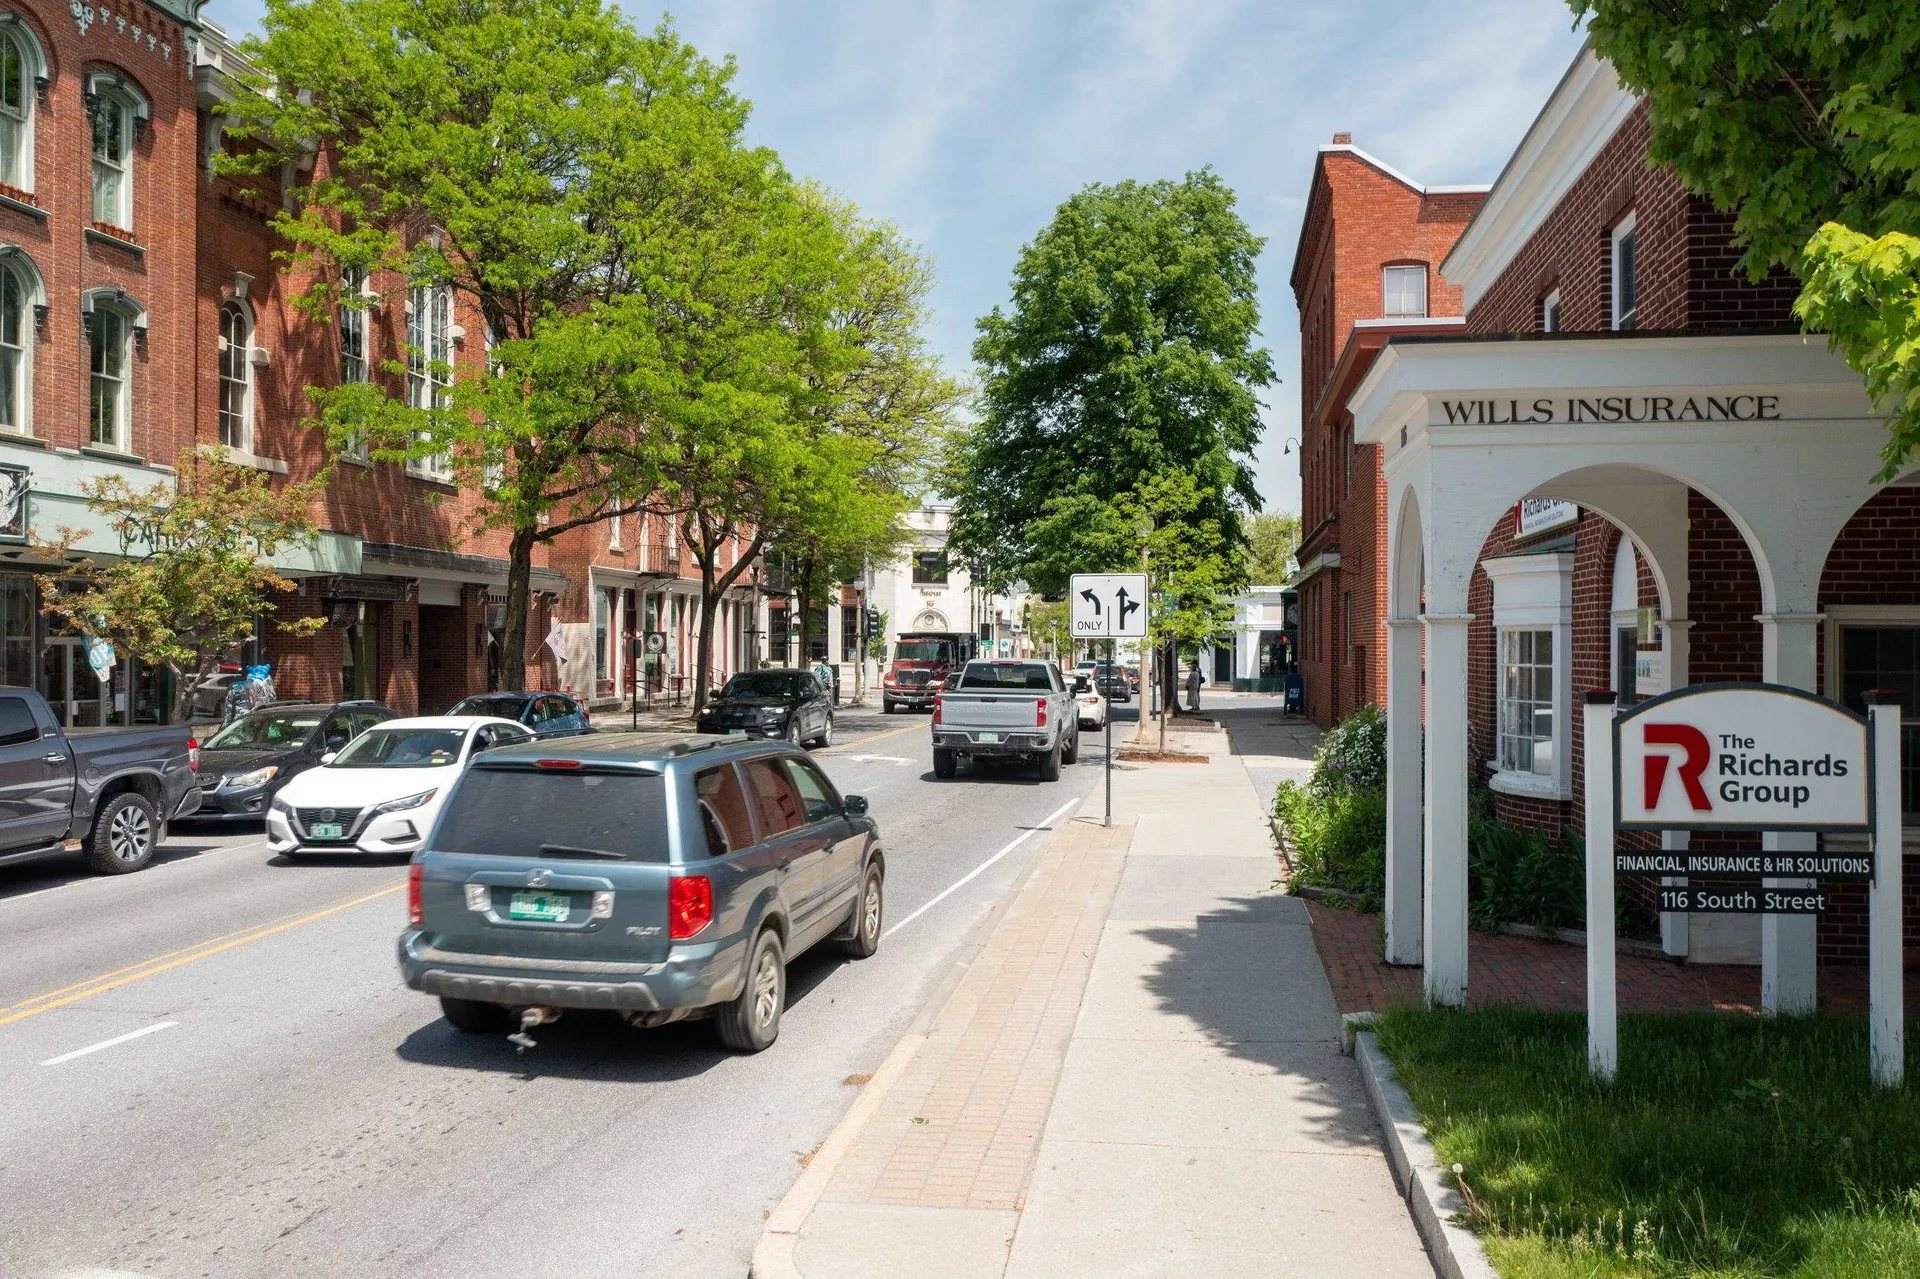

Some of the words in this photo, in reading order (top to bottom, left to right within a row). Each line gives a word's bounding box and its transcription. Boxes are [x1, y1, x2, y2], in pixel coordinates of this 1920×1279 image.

[1442, 399, 1554, 424] WILLS
[1567, 395, 1781, 422] INSURANCE
[1077, 620, 1102, 631] ONLY
[1719, 734, 1755, 749] The
[1719, 754, 1848, 777] Richards
[1719, 780, 1810, 808] Group
[1616, 856, 1686, 872] FINANCIAL,
[1688, 857, 1761, 872] INSURANCE
[1764, 858, 1773, 872] &
[1776, 858, 1794, 872] HR
[1797, 857, 1870, 873] SOLUTIONS
[1661, 891, 1688, 907] 116
[1697, 891, 1756, 909] South
[1764, 892, 1825, 910] Street
